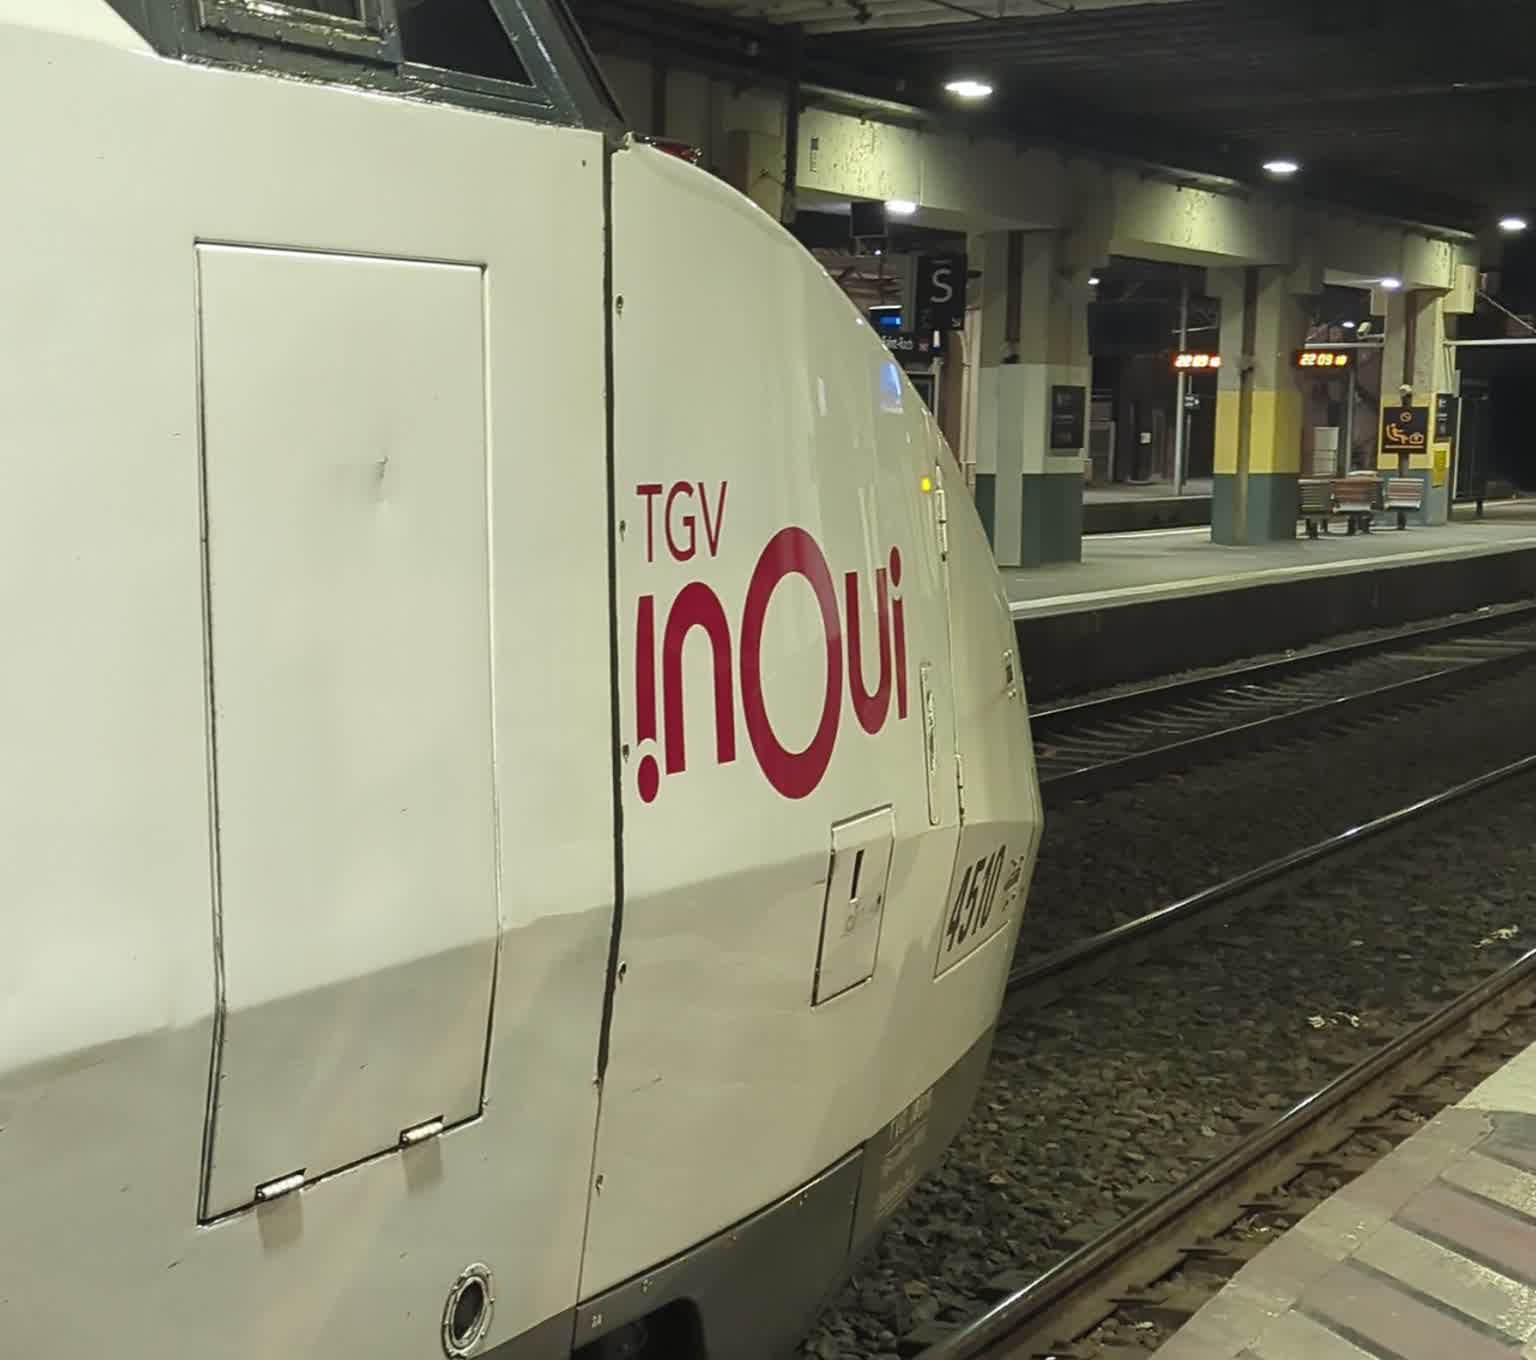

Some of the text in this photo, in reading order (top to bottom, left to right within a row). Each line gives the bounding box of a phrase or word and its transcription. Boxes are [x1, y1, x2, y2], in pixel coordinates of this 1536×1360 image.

[929, 268, 953, 303] S
[636, 481, 728, 562] TGV
[946, 844, 1006, 952] 4510
